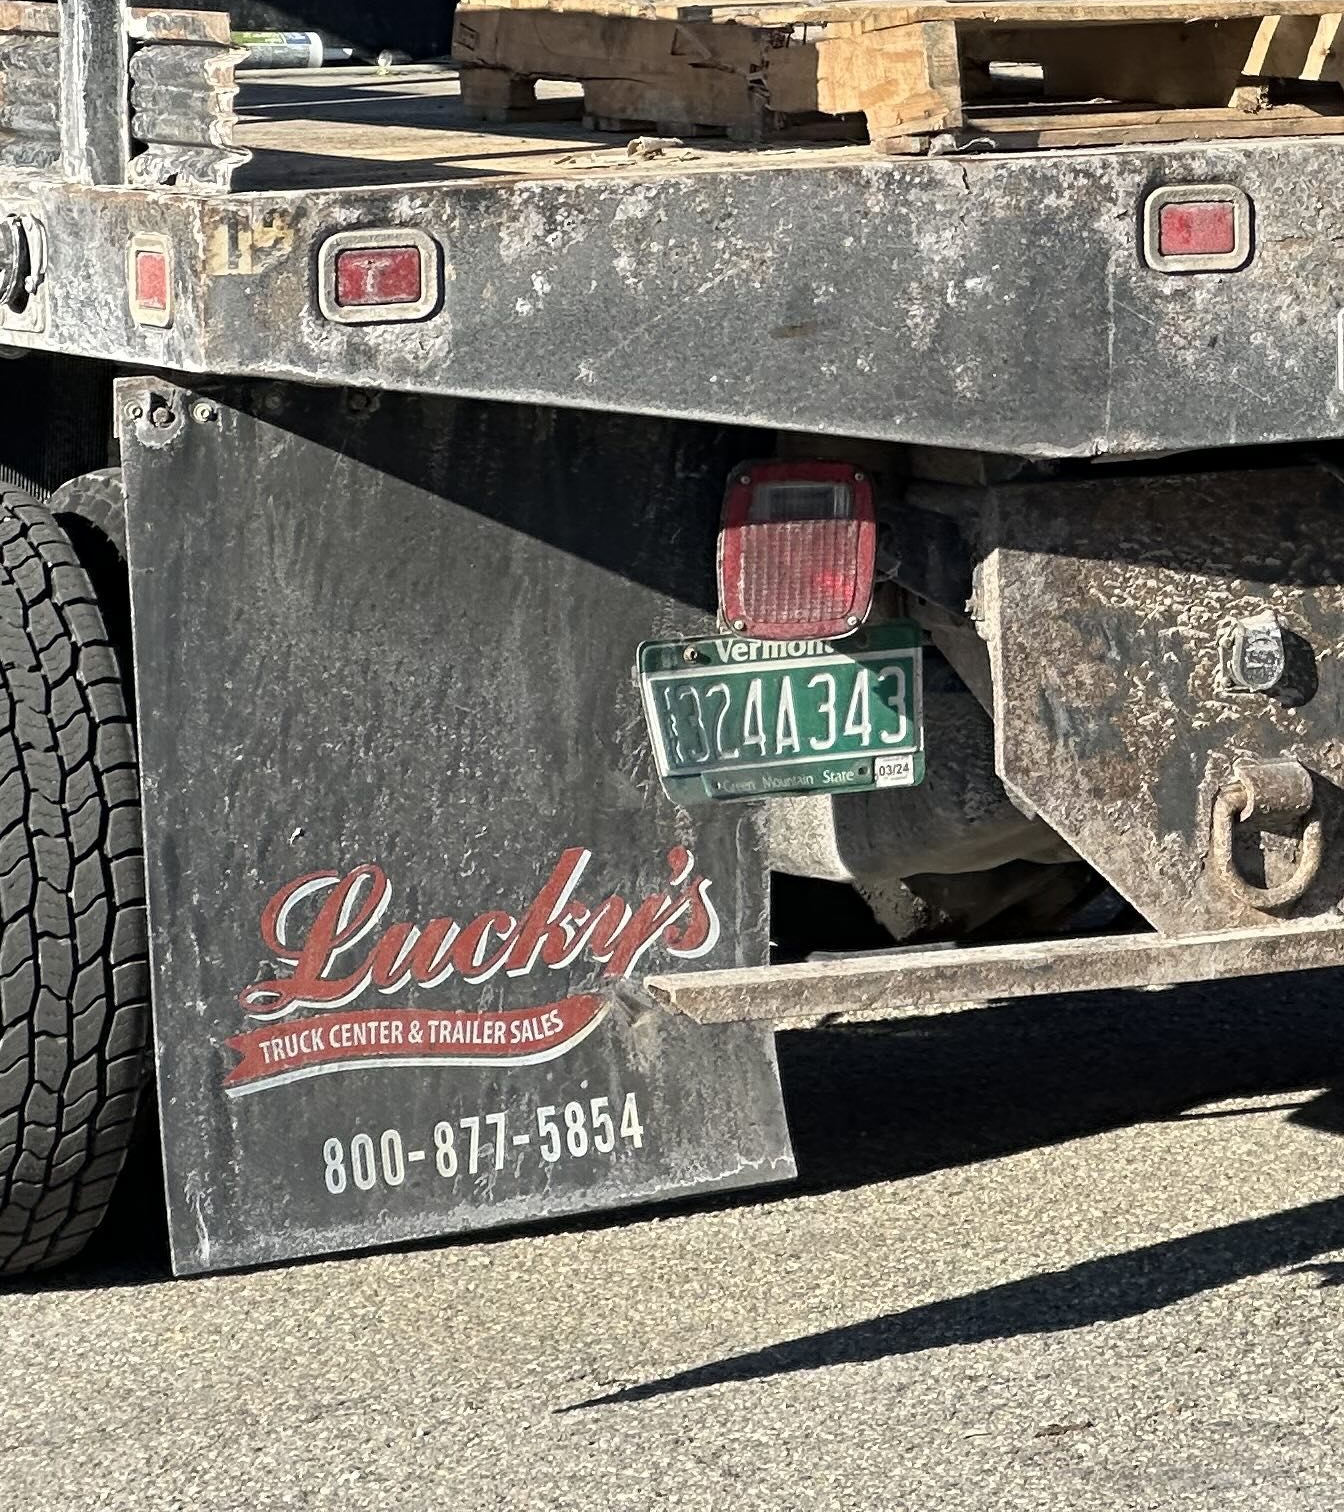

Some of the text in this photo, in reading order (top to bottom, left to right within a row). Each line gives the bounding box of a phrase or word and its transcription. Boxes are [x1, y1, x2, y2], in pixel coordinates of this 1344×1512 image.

[714, 639, 834, 664] Vermont
[762, 775, 814, 788] Mountain
[822, 769, 855, 784] State
[878, 764, 910, 777] 03/24
[238, 844, 721, 1021] Lucky's
[259, 1008, 565, 1065] TRUCK CENTER & TRAILER SALES
[322, 1091, 645, 1195] 800-877-5854
